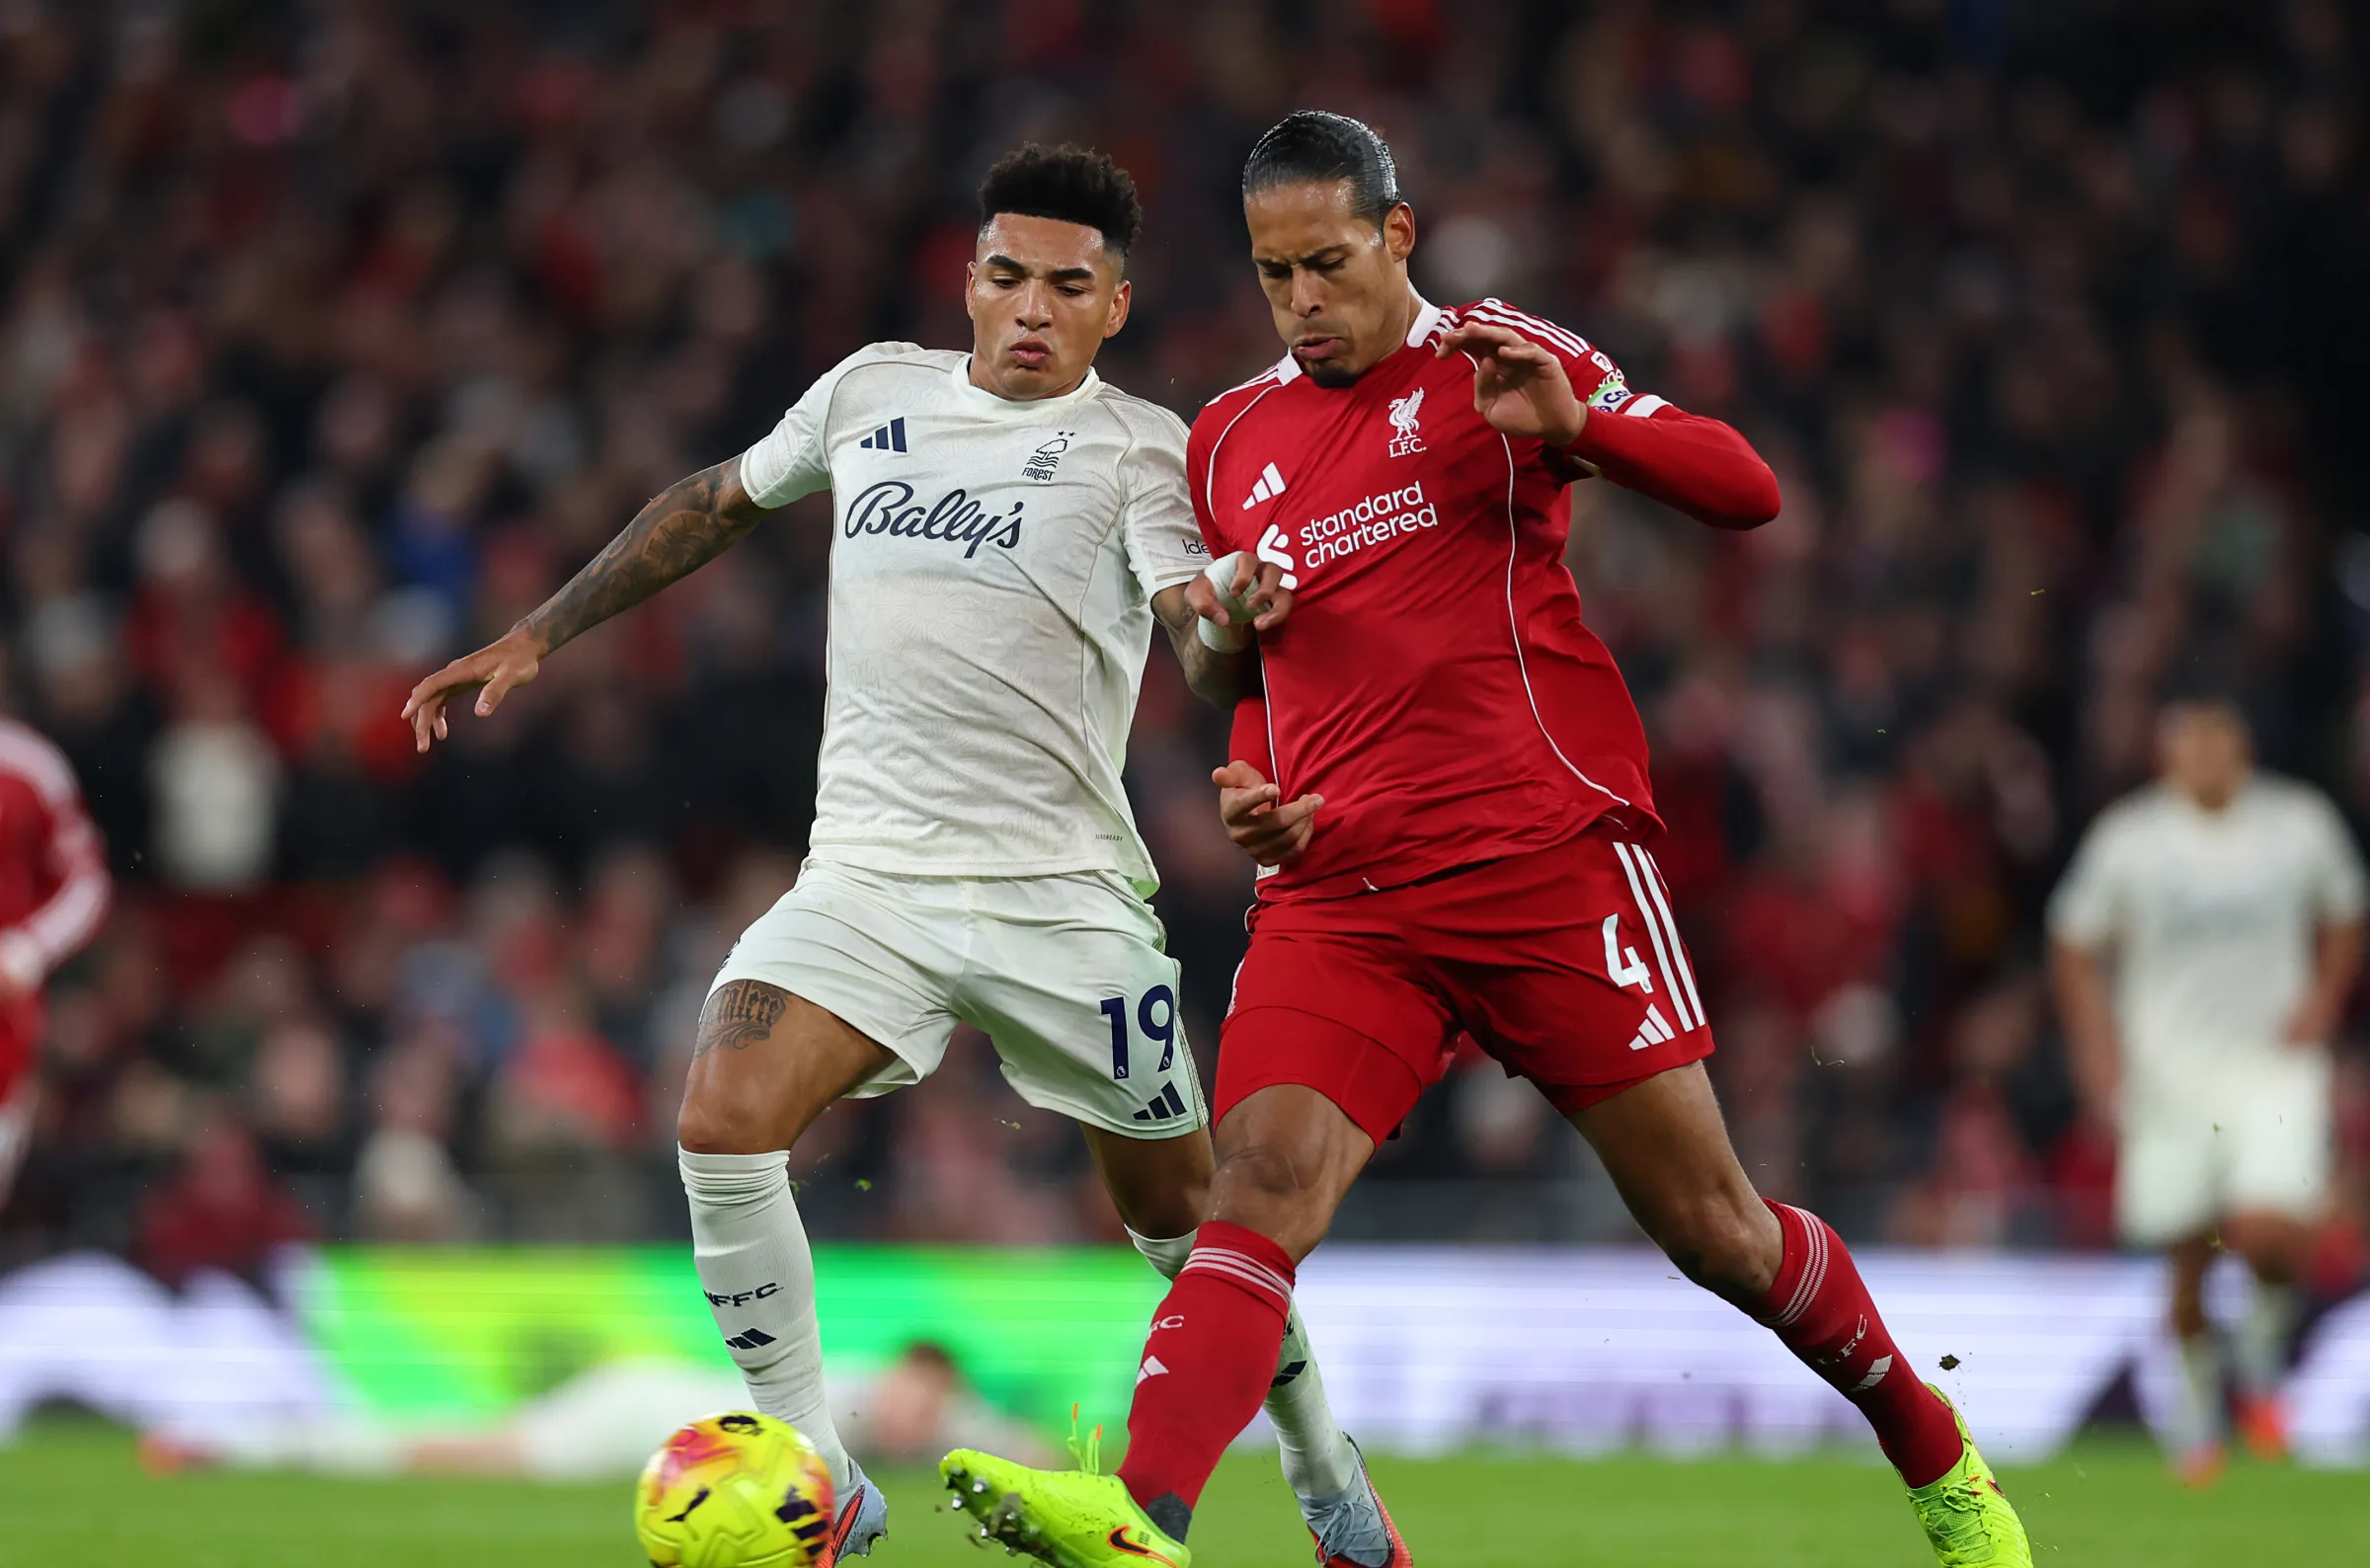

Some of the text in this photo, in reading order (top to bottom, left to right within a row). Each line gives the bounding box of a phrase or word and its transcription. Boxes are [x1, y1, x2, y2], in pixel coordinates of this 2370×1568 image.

[845, 481, 1024, 559] Bally's
[1300, 480, 1424, 546] standard
[1304, 503, 1439, 569] chartered
[1602, 912, 1655, 994] 4
[1100, 984, 1175, 1080] 19
